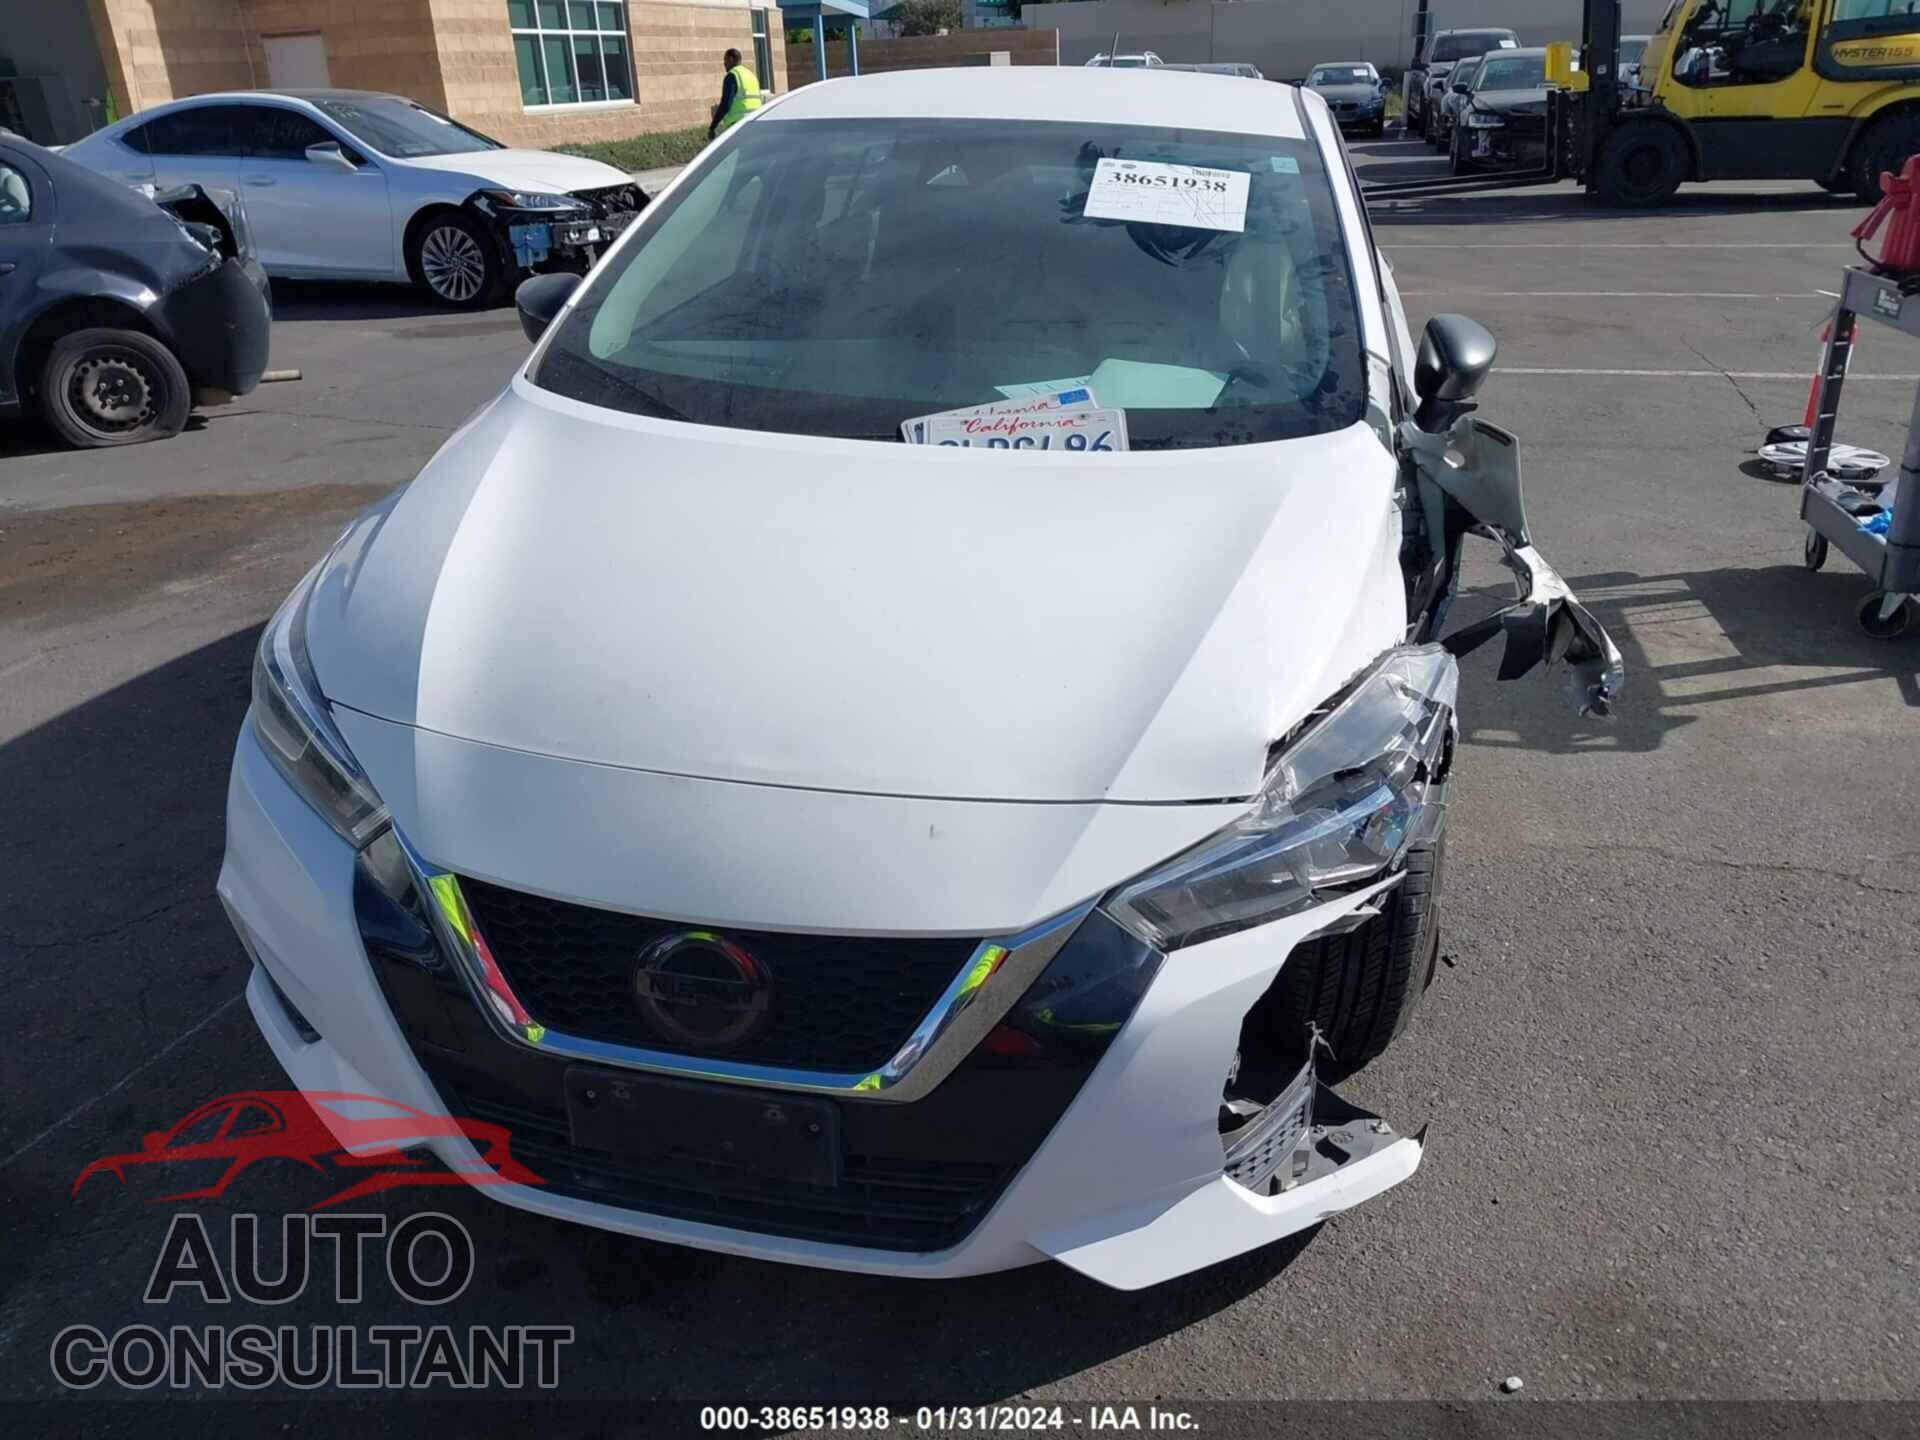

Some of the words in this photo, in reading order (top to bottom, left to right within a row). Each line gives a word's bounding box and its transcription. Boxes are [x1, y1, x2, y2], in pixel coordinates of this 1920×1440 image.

[1833, 47, 1887, 58] HYSTER
[1107, 172, 1227, 192] 38651938
[965, 417, 1086, 435] California
